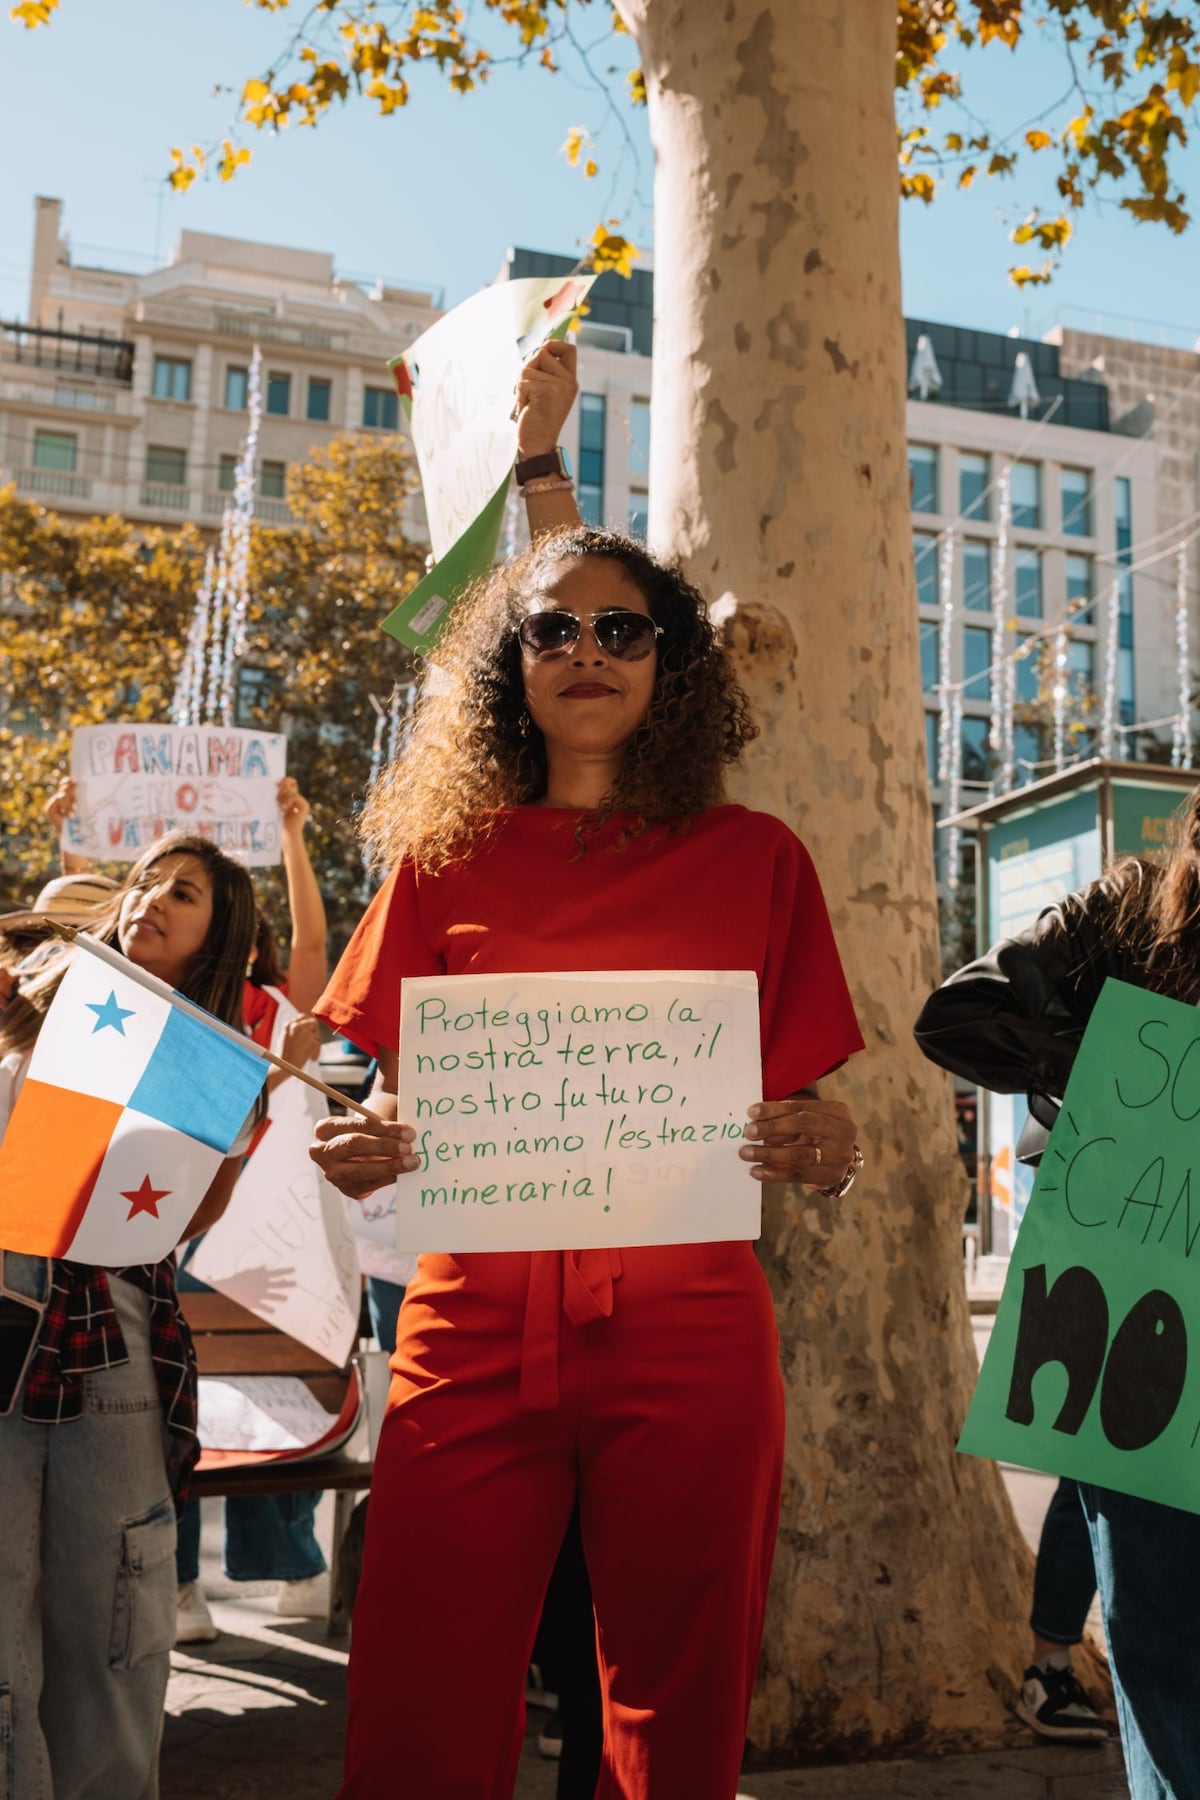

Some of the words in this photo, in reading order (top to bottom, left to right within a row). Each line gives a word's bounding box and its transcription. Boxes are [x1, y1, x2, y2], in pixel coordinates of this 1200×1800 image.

[415, 998, 649, 1047] Proteggiamo
[667, 998, 703, 1022] la
[416, 1038, 543, 1073] nostra
[557, 1033, 679, 1067] terra,
[693, 1023, 722, 1059] il
[416, 1081, 542, 1118] nostro
[554, 1073, 687, 1121] futuro,
[414, 1127, 585, 1172] fermiamo
[603, 1113, 747, 1151] l'estrazio
[420, 1167, 613, 1212] mineraria!
